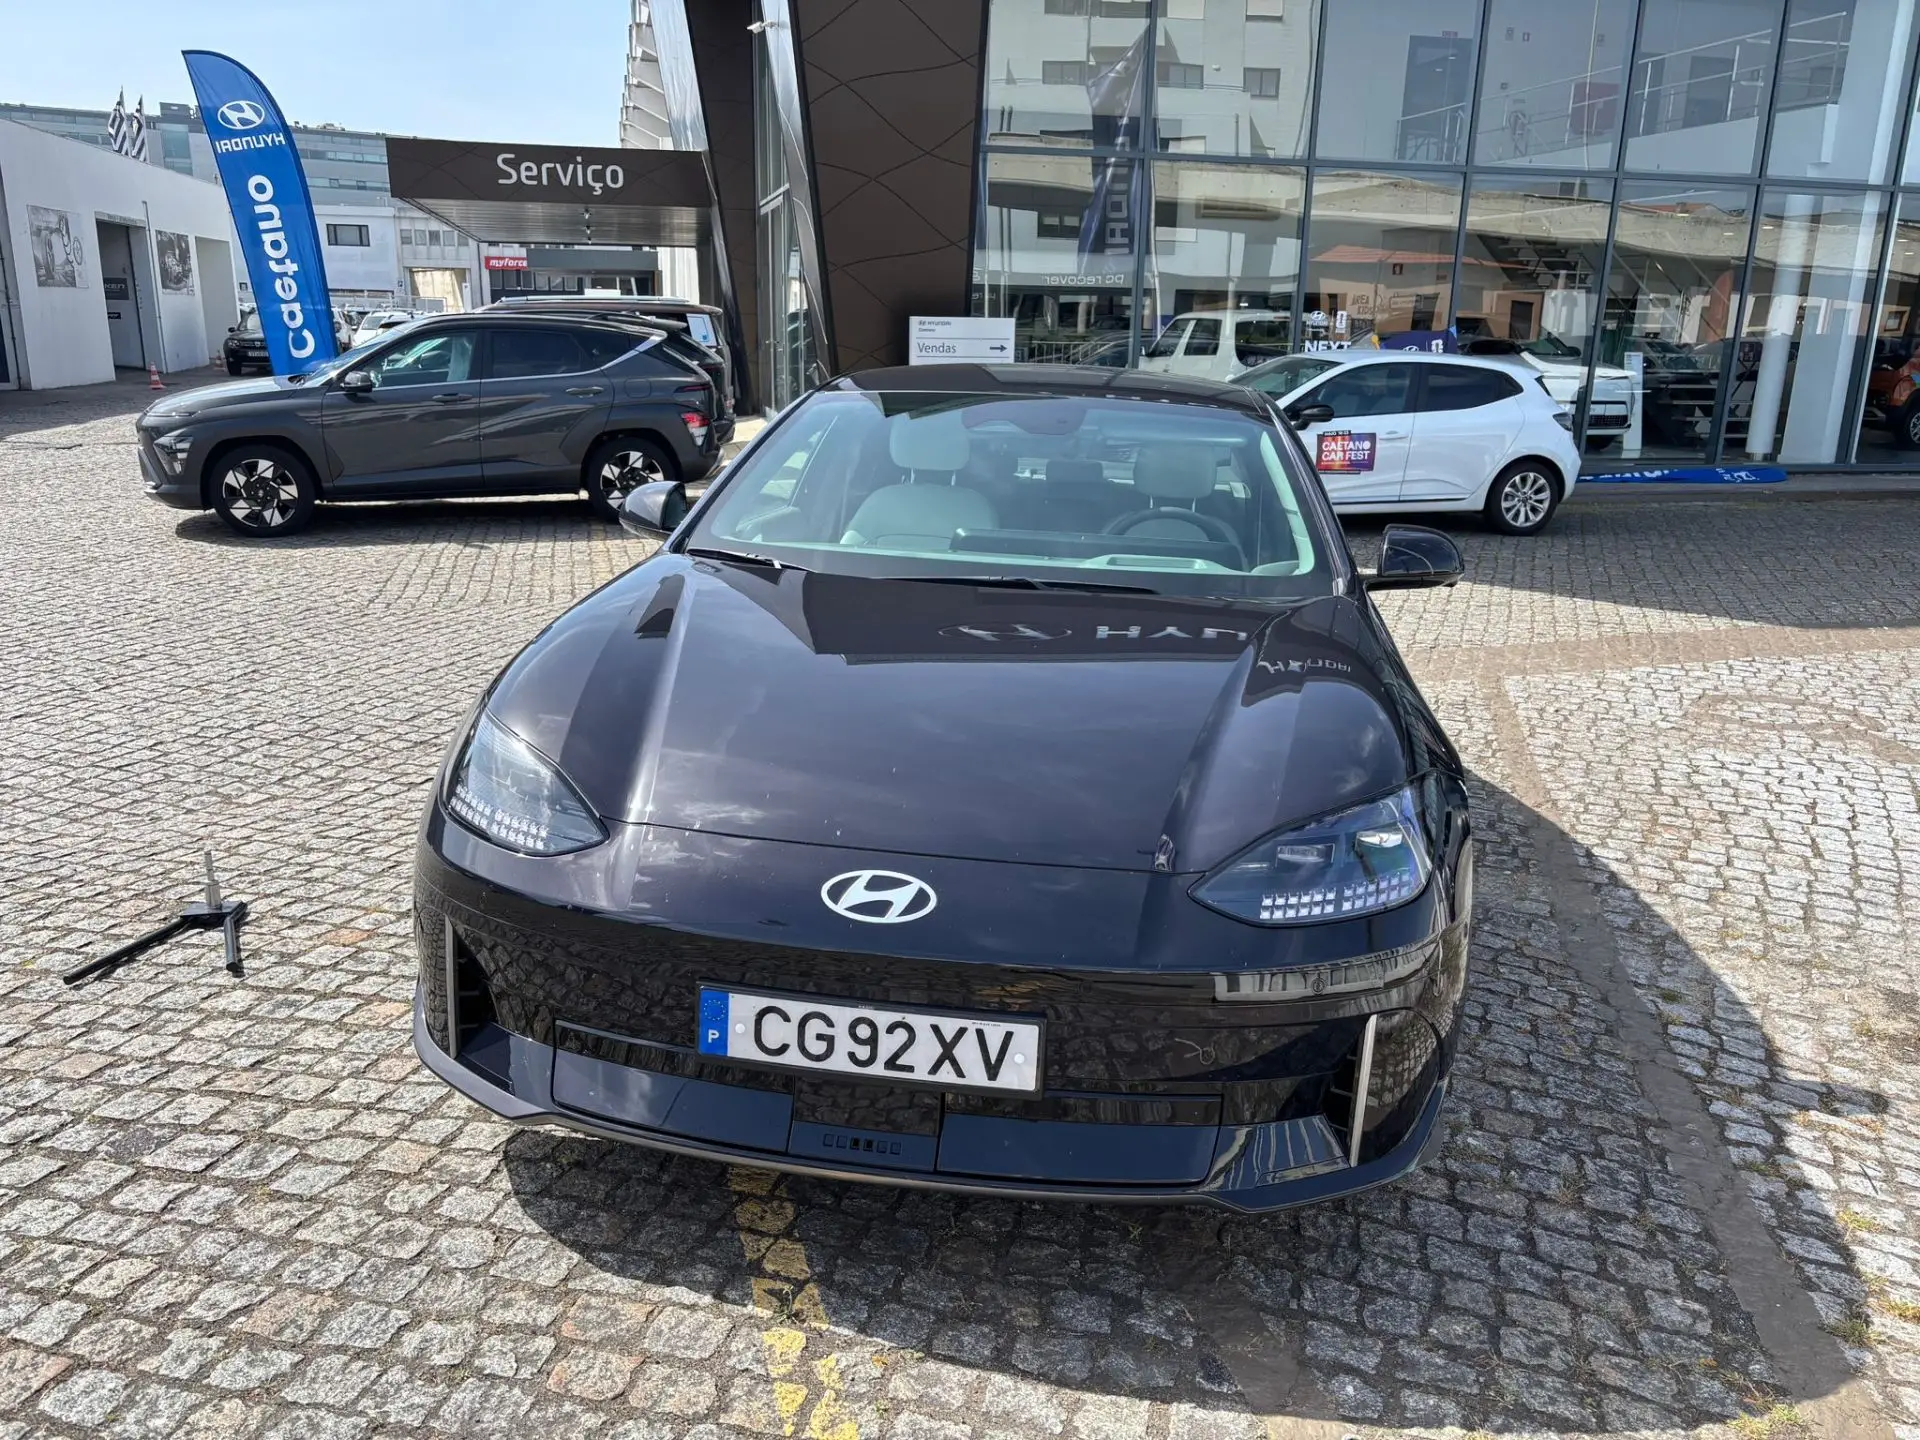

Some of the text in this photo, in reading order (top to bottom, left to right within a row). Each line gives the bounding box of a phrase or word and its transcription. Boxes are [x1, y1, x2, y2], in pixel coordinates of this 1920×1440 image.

[496, 153, 624, 195] Serviço
[917, 341, 957, 354] Vendas
[1304, 340, 1352, 353] NEXT
[1321, 441, 1371, 451] CAETANO
[1321, 451, 1371, 461] CAR FEST
[707, 1029, 720, 1043] P
